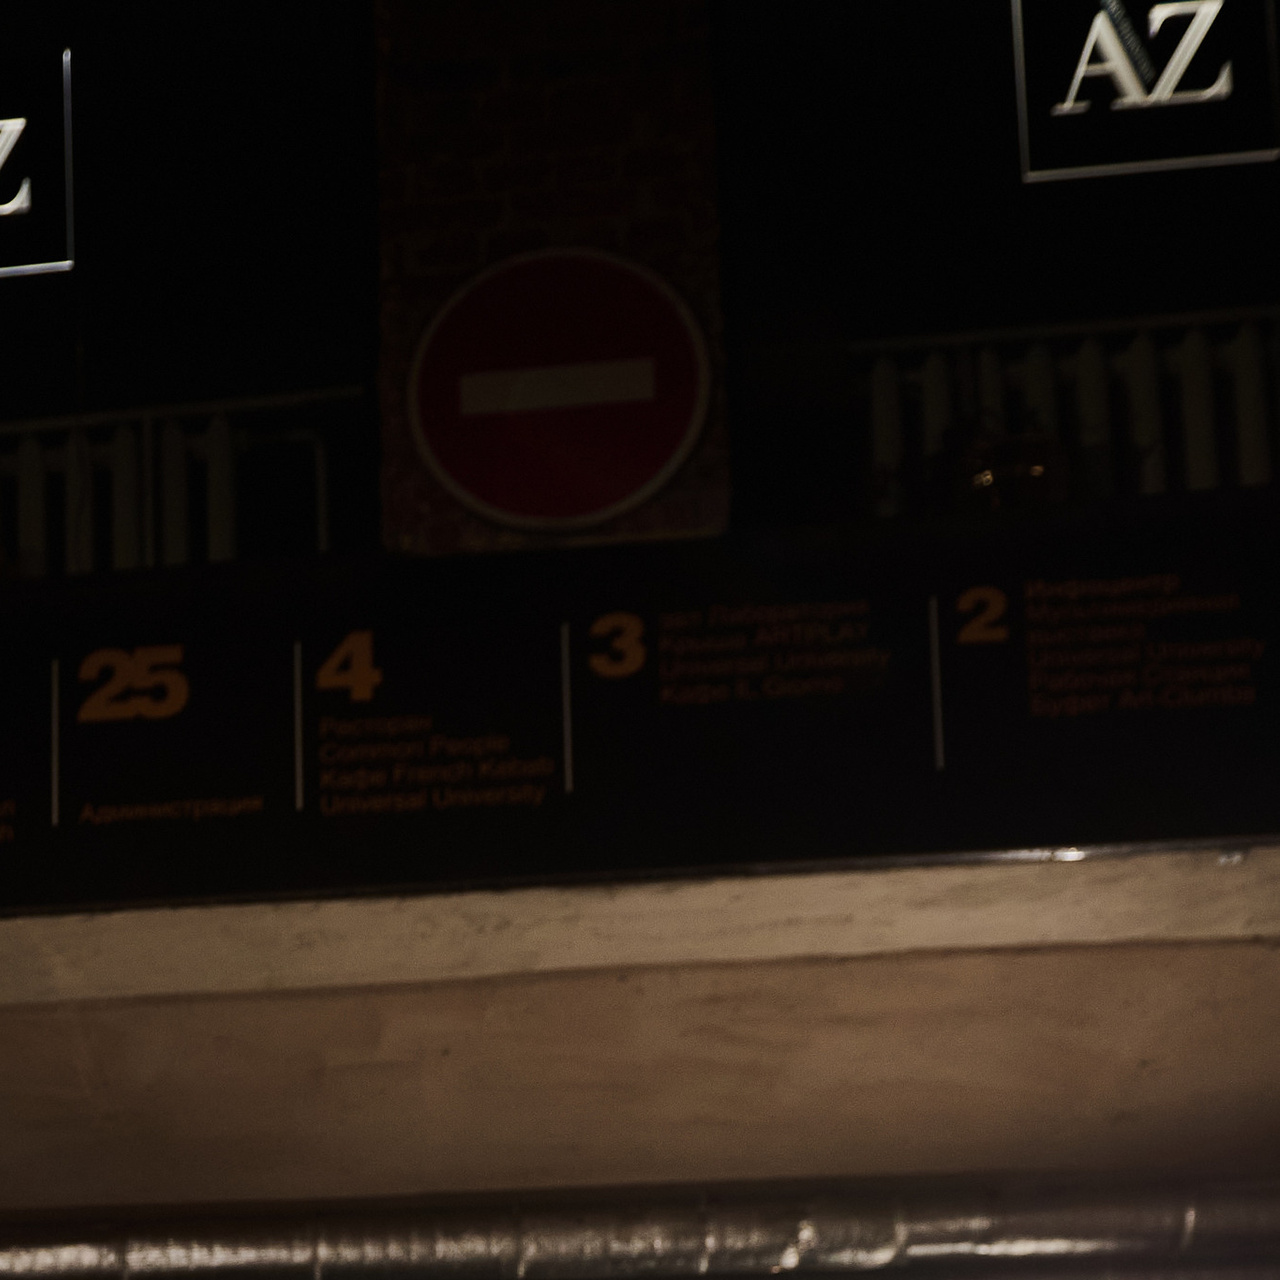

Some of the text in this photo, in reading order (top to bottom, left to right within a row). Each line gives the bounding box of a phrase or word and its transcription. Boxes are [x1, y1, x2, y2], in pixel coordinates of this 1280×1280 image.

[1050, 0, 1233, 117] AZ
[587, 609, 648, 680] 3
[751, 619, 870, 646] ARTPLAY
[954, 584, 1011, 646] 2
[75, 641, 192, 725] 25
[314, 627, 384, 703] 4
[77, 795, 265, 827] Администрация
[320, 782, 548, 817] Universal University
